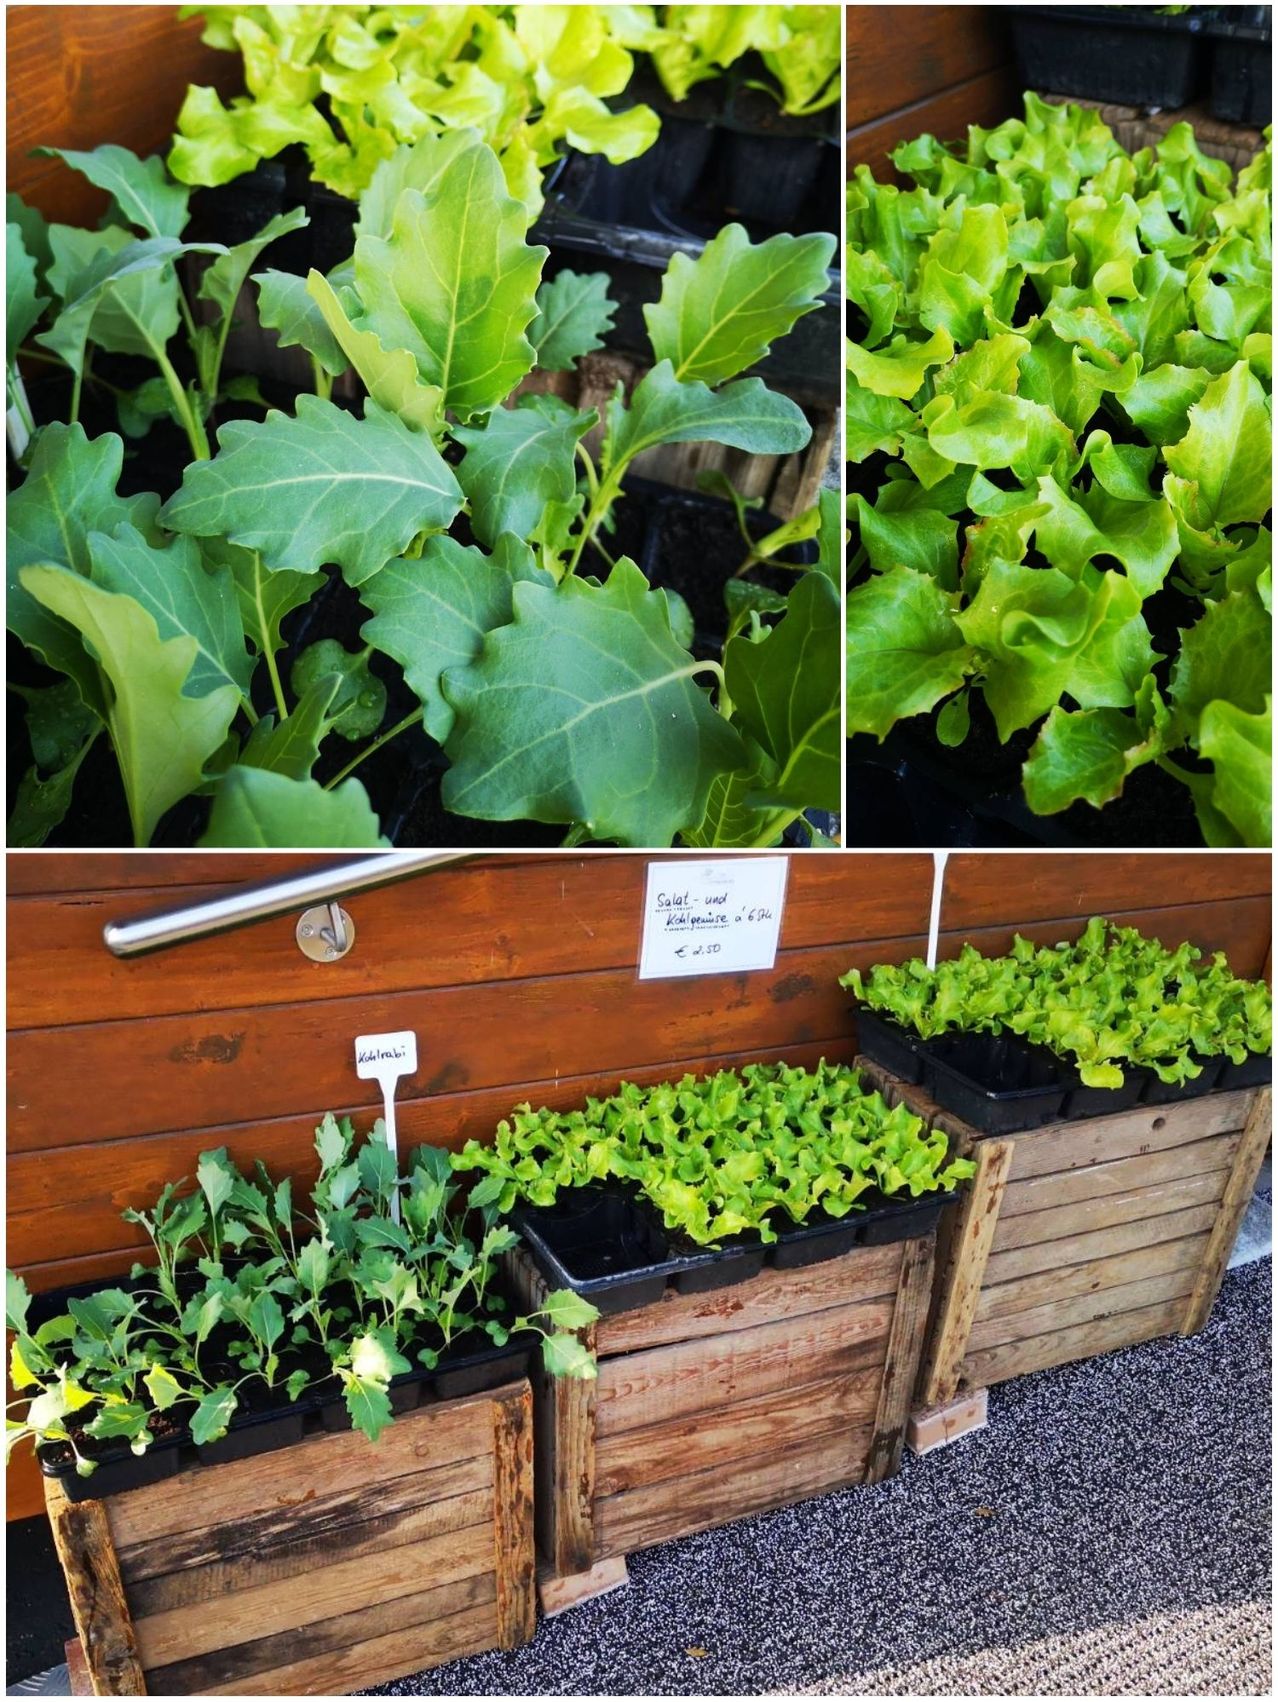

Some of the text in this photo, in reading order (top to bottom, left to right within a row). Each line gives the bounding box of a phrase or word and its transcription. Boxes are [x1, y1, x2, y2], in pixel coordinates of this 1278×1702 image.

[705, 892, 728, 905] und
[674, 945, 688, 958] €
[358, 1045, 405, 1063] Kohlrabi
